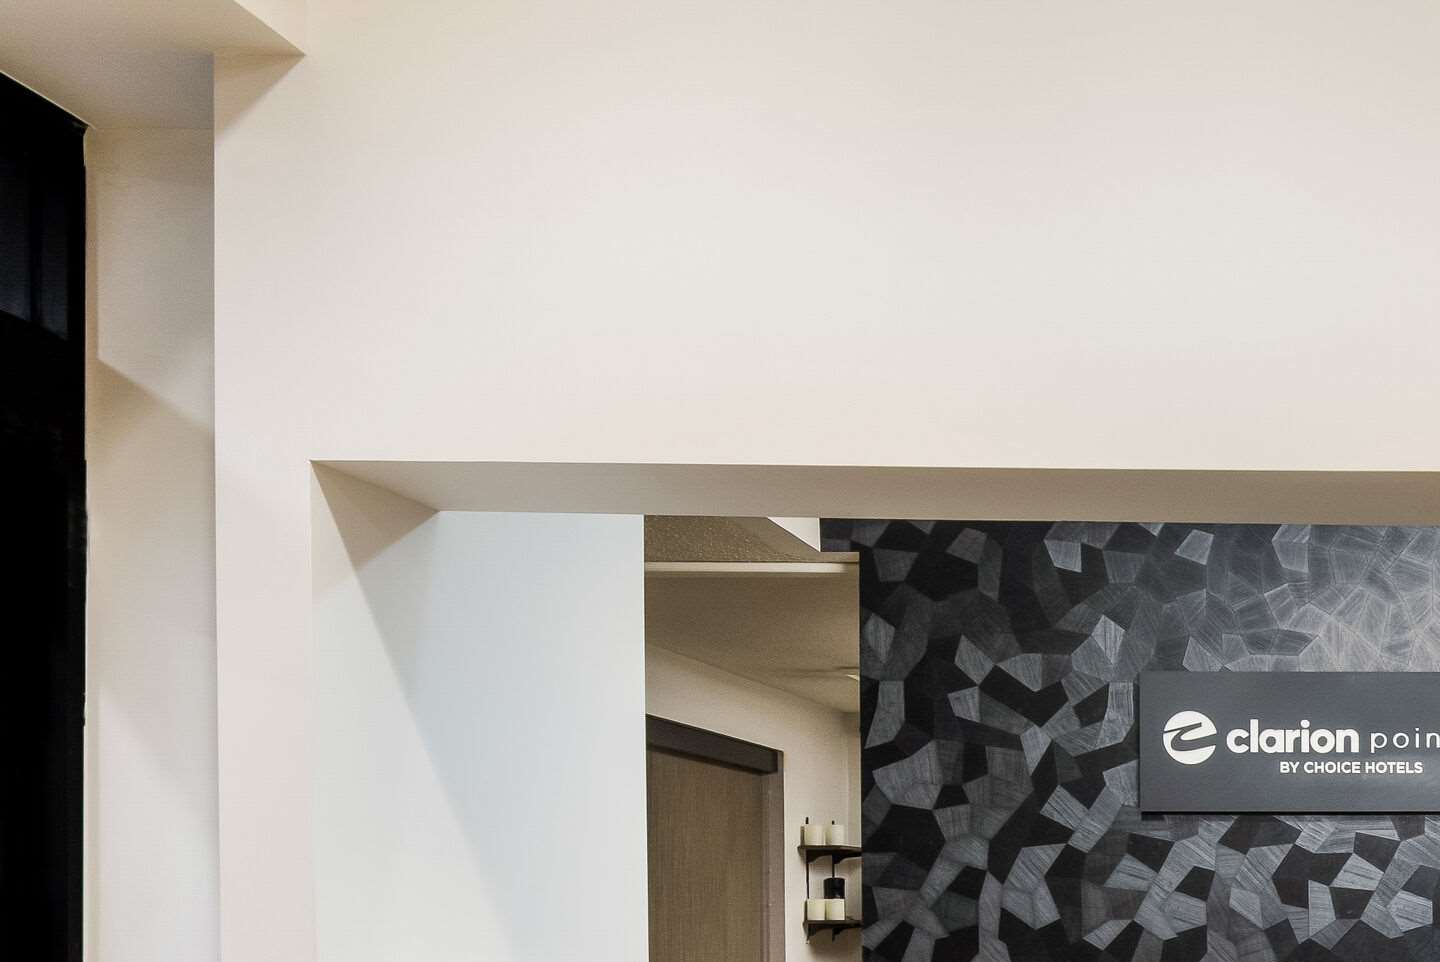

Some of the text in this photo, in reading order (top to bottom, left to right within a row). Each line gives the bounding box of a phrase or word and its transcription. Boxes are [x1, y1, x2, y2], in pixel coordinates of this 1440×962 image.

[1226, 718, 1360, 754] clarion
[1279, 761, 1424, 774] BY CHOICE HOTELS
